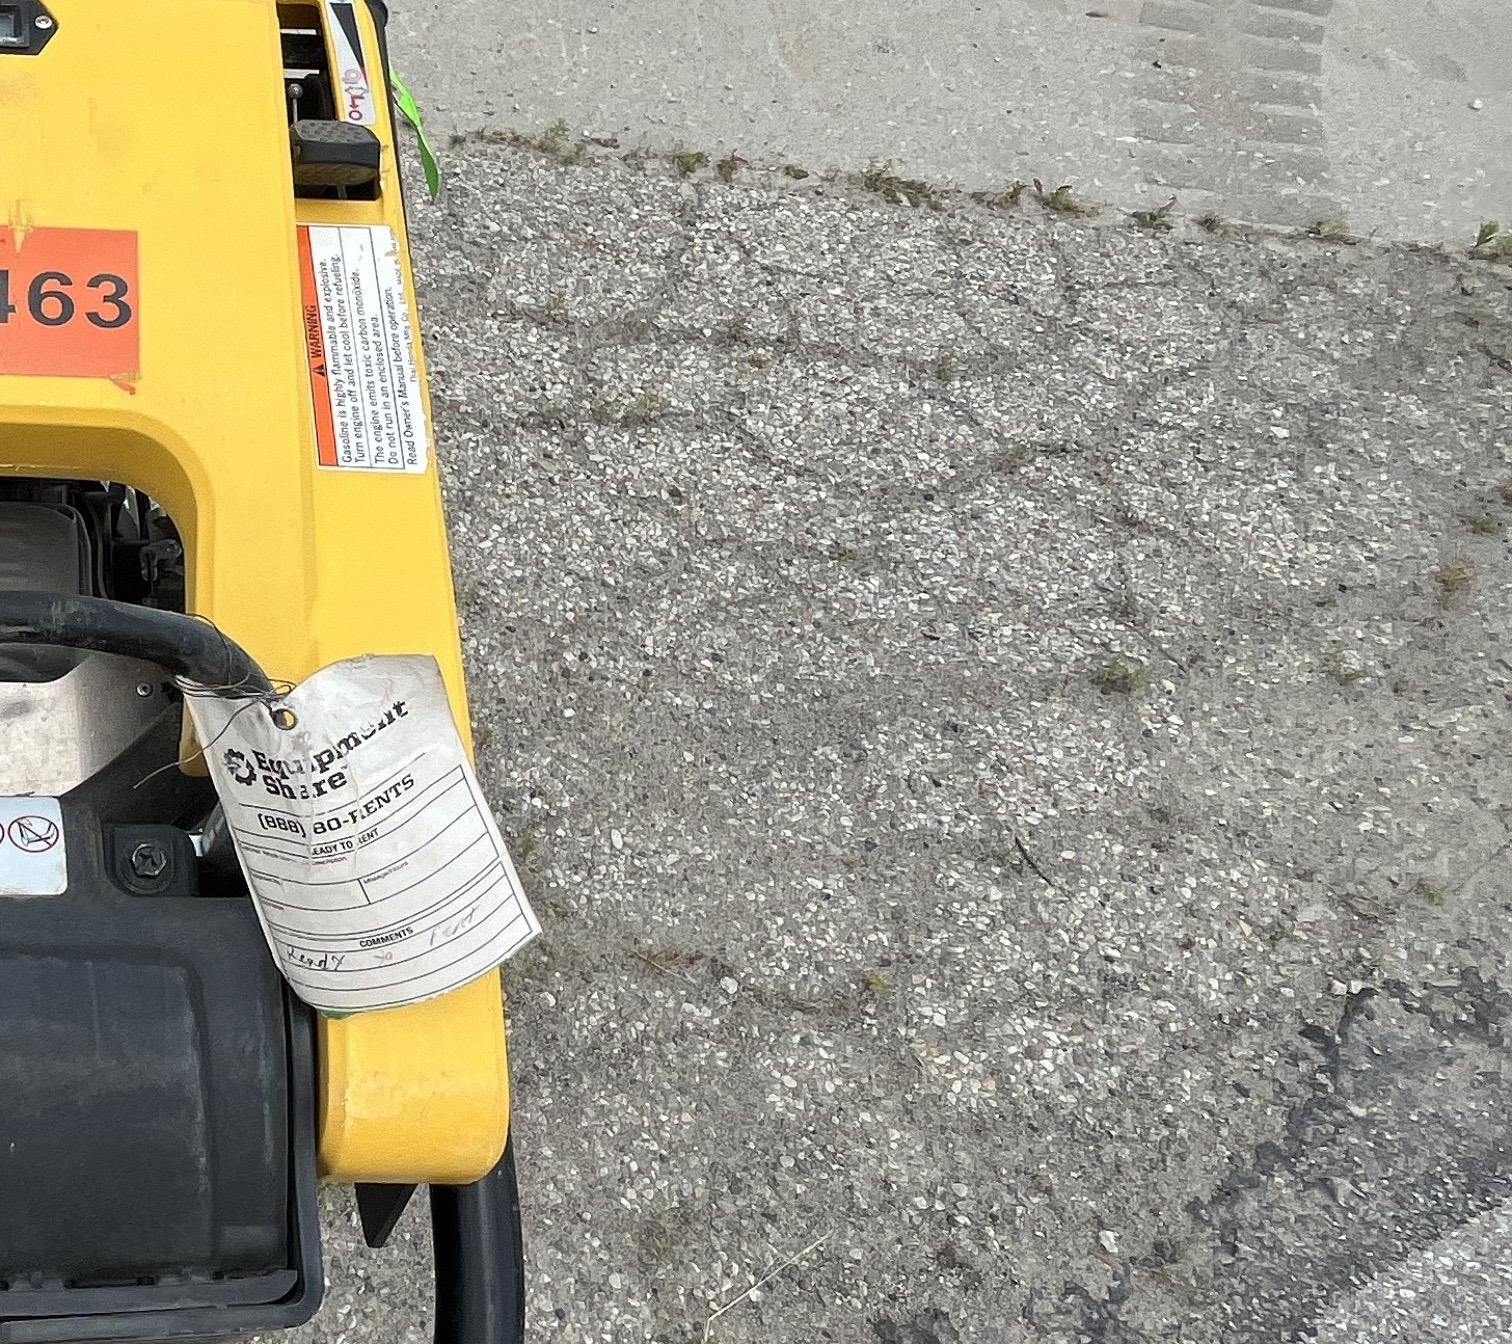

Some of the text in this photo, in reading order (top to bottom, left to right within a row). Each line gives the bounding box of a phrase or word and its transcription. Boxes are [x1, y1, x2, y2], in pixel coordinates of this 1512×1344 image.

[323, 305, 335, 322] and
[305, 305, 321, 358] WARNING
[358, 319, 369, 351] carbon
[327, 326, 341, 375] flammable
[331, 254, 365, 462] Turn engine off and let cool before refueling.
[391, 333, 402, 362] before
[362, 355, 373, 377] toxic
[334, 379, 346, 406] highly
[366, 381, 377, 406] emits
[371, 315, 398, 464] Do not run in an enclosed area.
[395, 365, 408, 398] Manual
[337, 410, 347, 418] is
[370, 410, 383, 442] engine
[400, 402, 413, 437] Owner's
[339, 422, 352, 462] Gasoline
[375, 446, 385, 463] The
[405, 441, 417, 464] Read
[262, 770, 348, 800] Share
[258, 813, 306, 838] (888)
[340, 840, 353, 850] TO
[360, 927, 414, 947] COMMENTS
